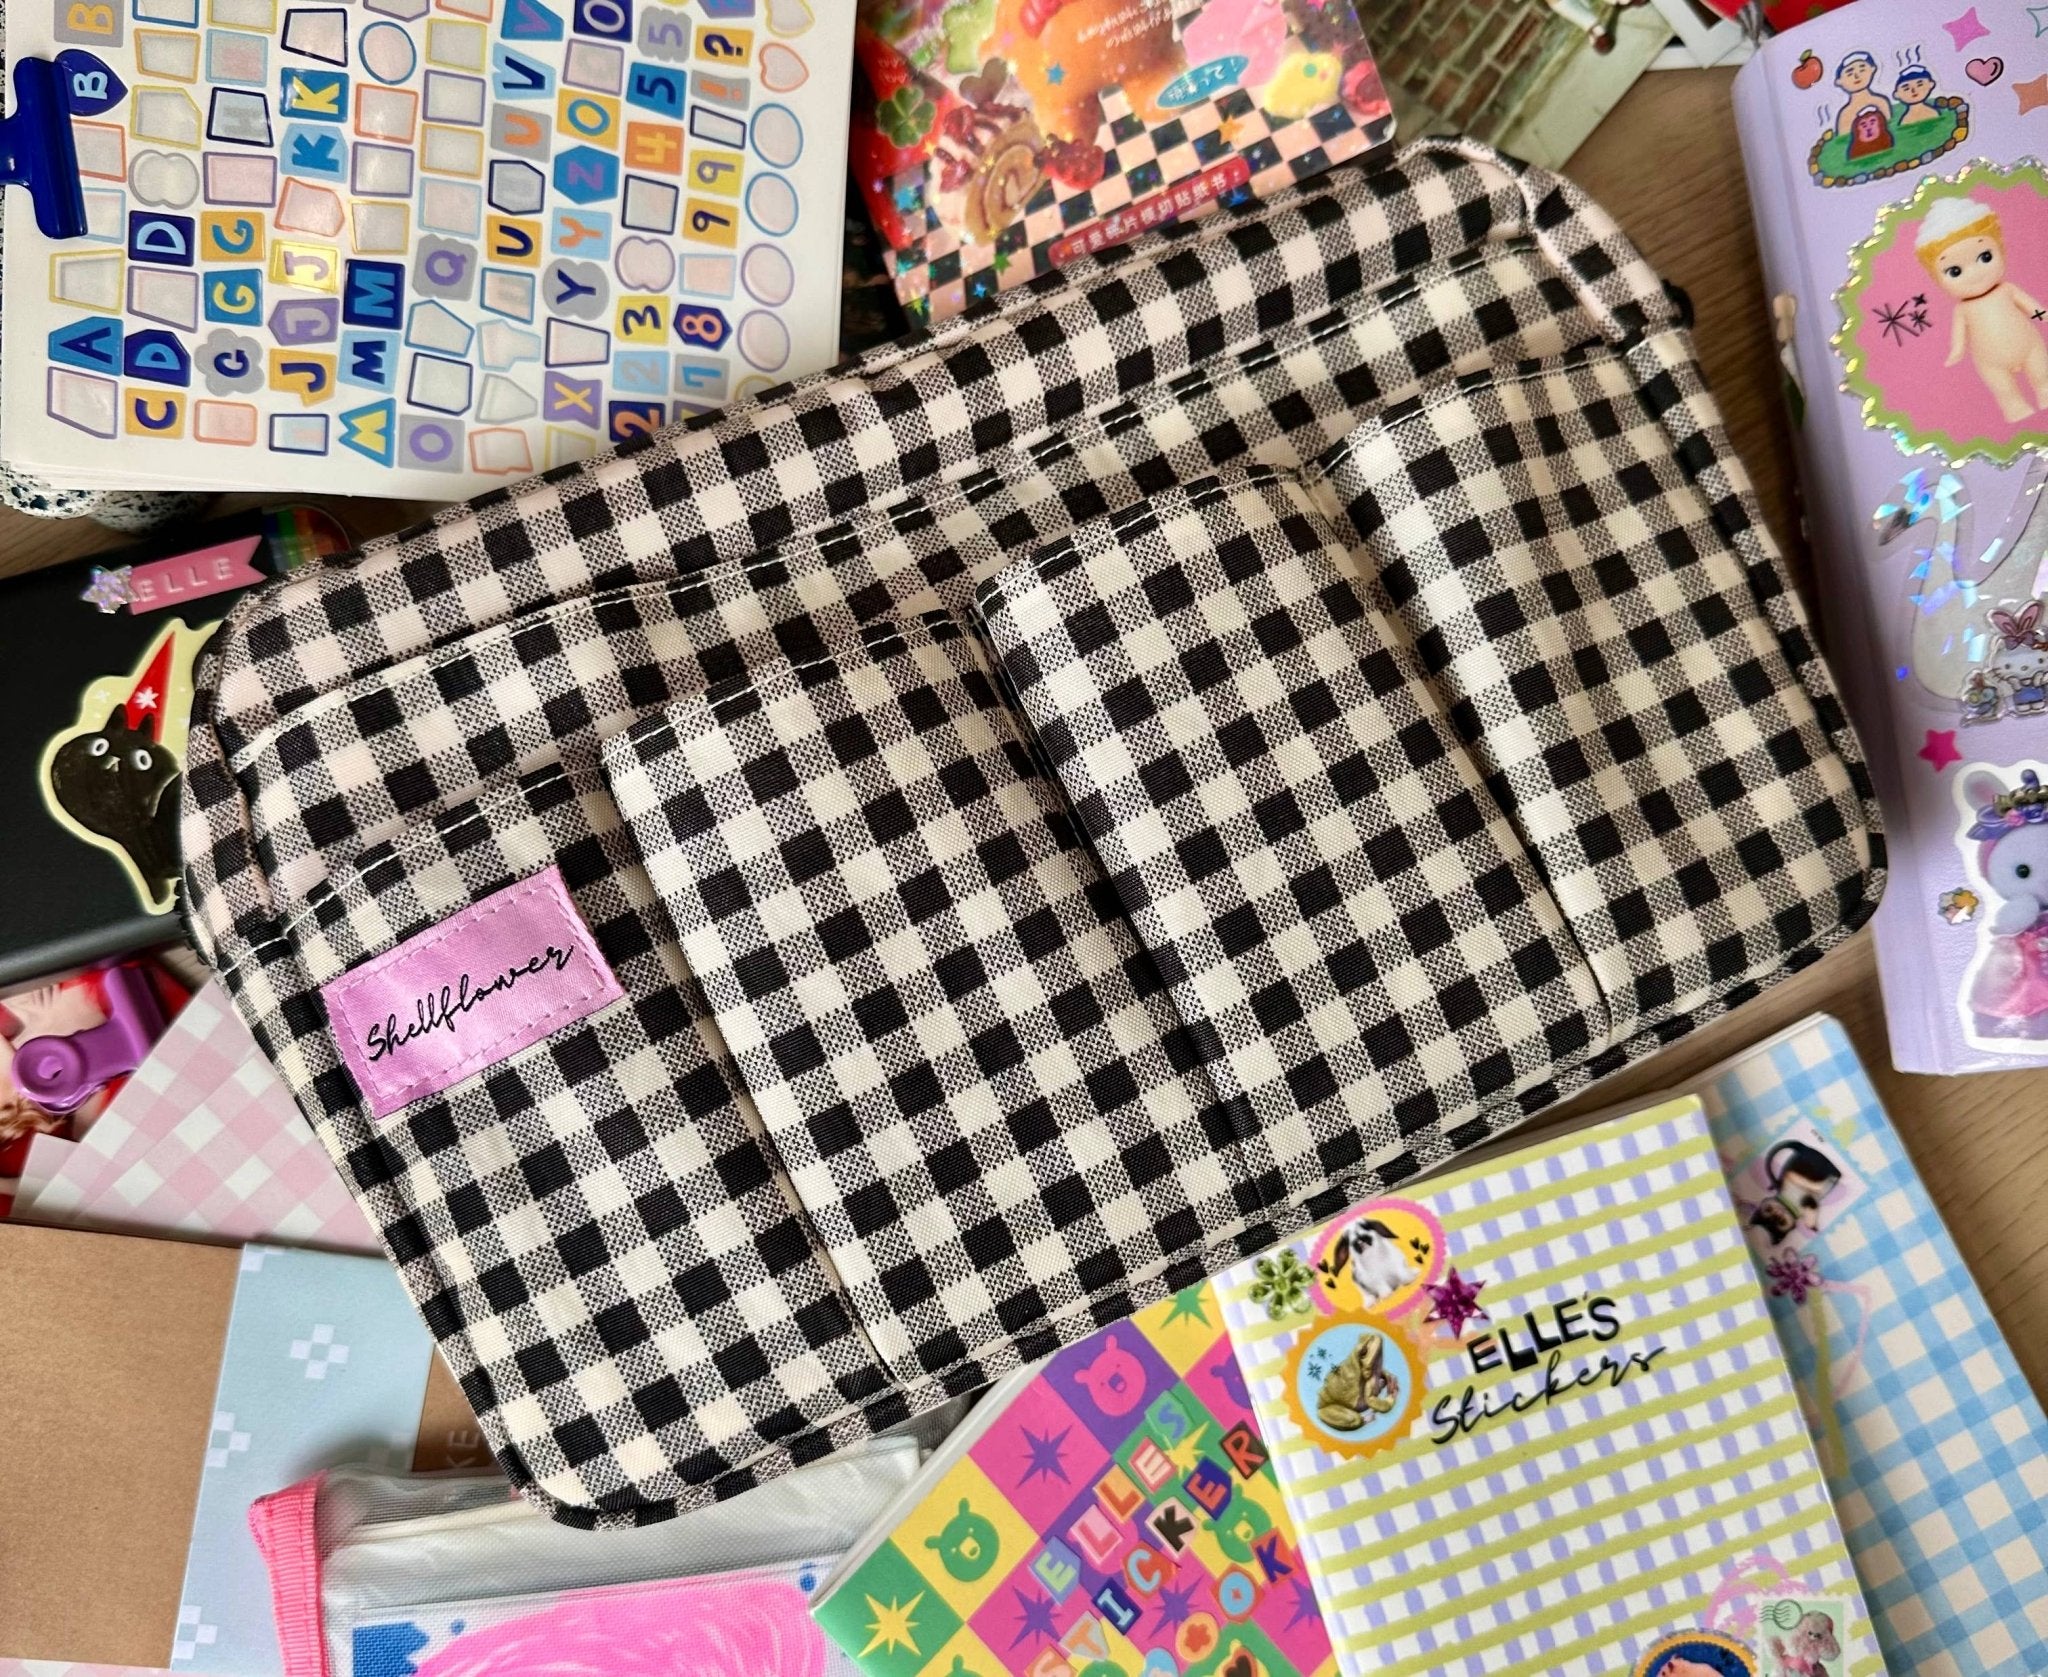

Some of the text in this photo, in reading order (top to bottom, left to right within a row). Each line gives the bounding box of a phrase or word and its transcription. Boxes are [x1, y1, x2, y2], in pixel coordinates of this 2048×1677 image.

[648, 23, 683, 48] 5
[704, 34, 743, 56] ?
[502, 56, 545, 89] V
[636, 75, 676, 104] 5
[505, 114, 542, 146] U
[636, 132, 677, 164] 4
[59, 4, 114, 364] A B B
[567, 162, 605, 187] Z
[697, 160, 735, 183] 9
[213, 219, 254, 253] G
[281, 77, 340, 392] J J J K K
[559, 216, 603, 248] Y
[693, 210, 730, 232] 9
[496, 225, 534, 257] U
[425, 250, 467, 285] Q
[212, 283, 256, 314] G
[556, 269, 597, 304] Y
[135, 221, 186, 428] C D D
[623, 305, 661, 334] 3
[682, 314, 722, 342] 8
[214, 349, 250, 377] G
[352, 269, 395, 453] M M M
[622, 358, 659, 385] 2
[554, 381, 594, 413] X
[138, 557, 234, 602] ELLE
[367, 945, 575, 1061] Shellflower
[1430, 1350, 1667, 1445] Stickers
[1034, 1400, 1187, 1593] ELLES
